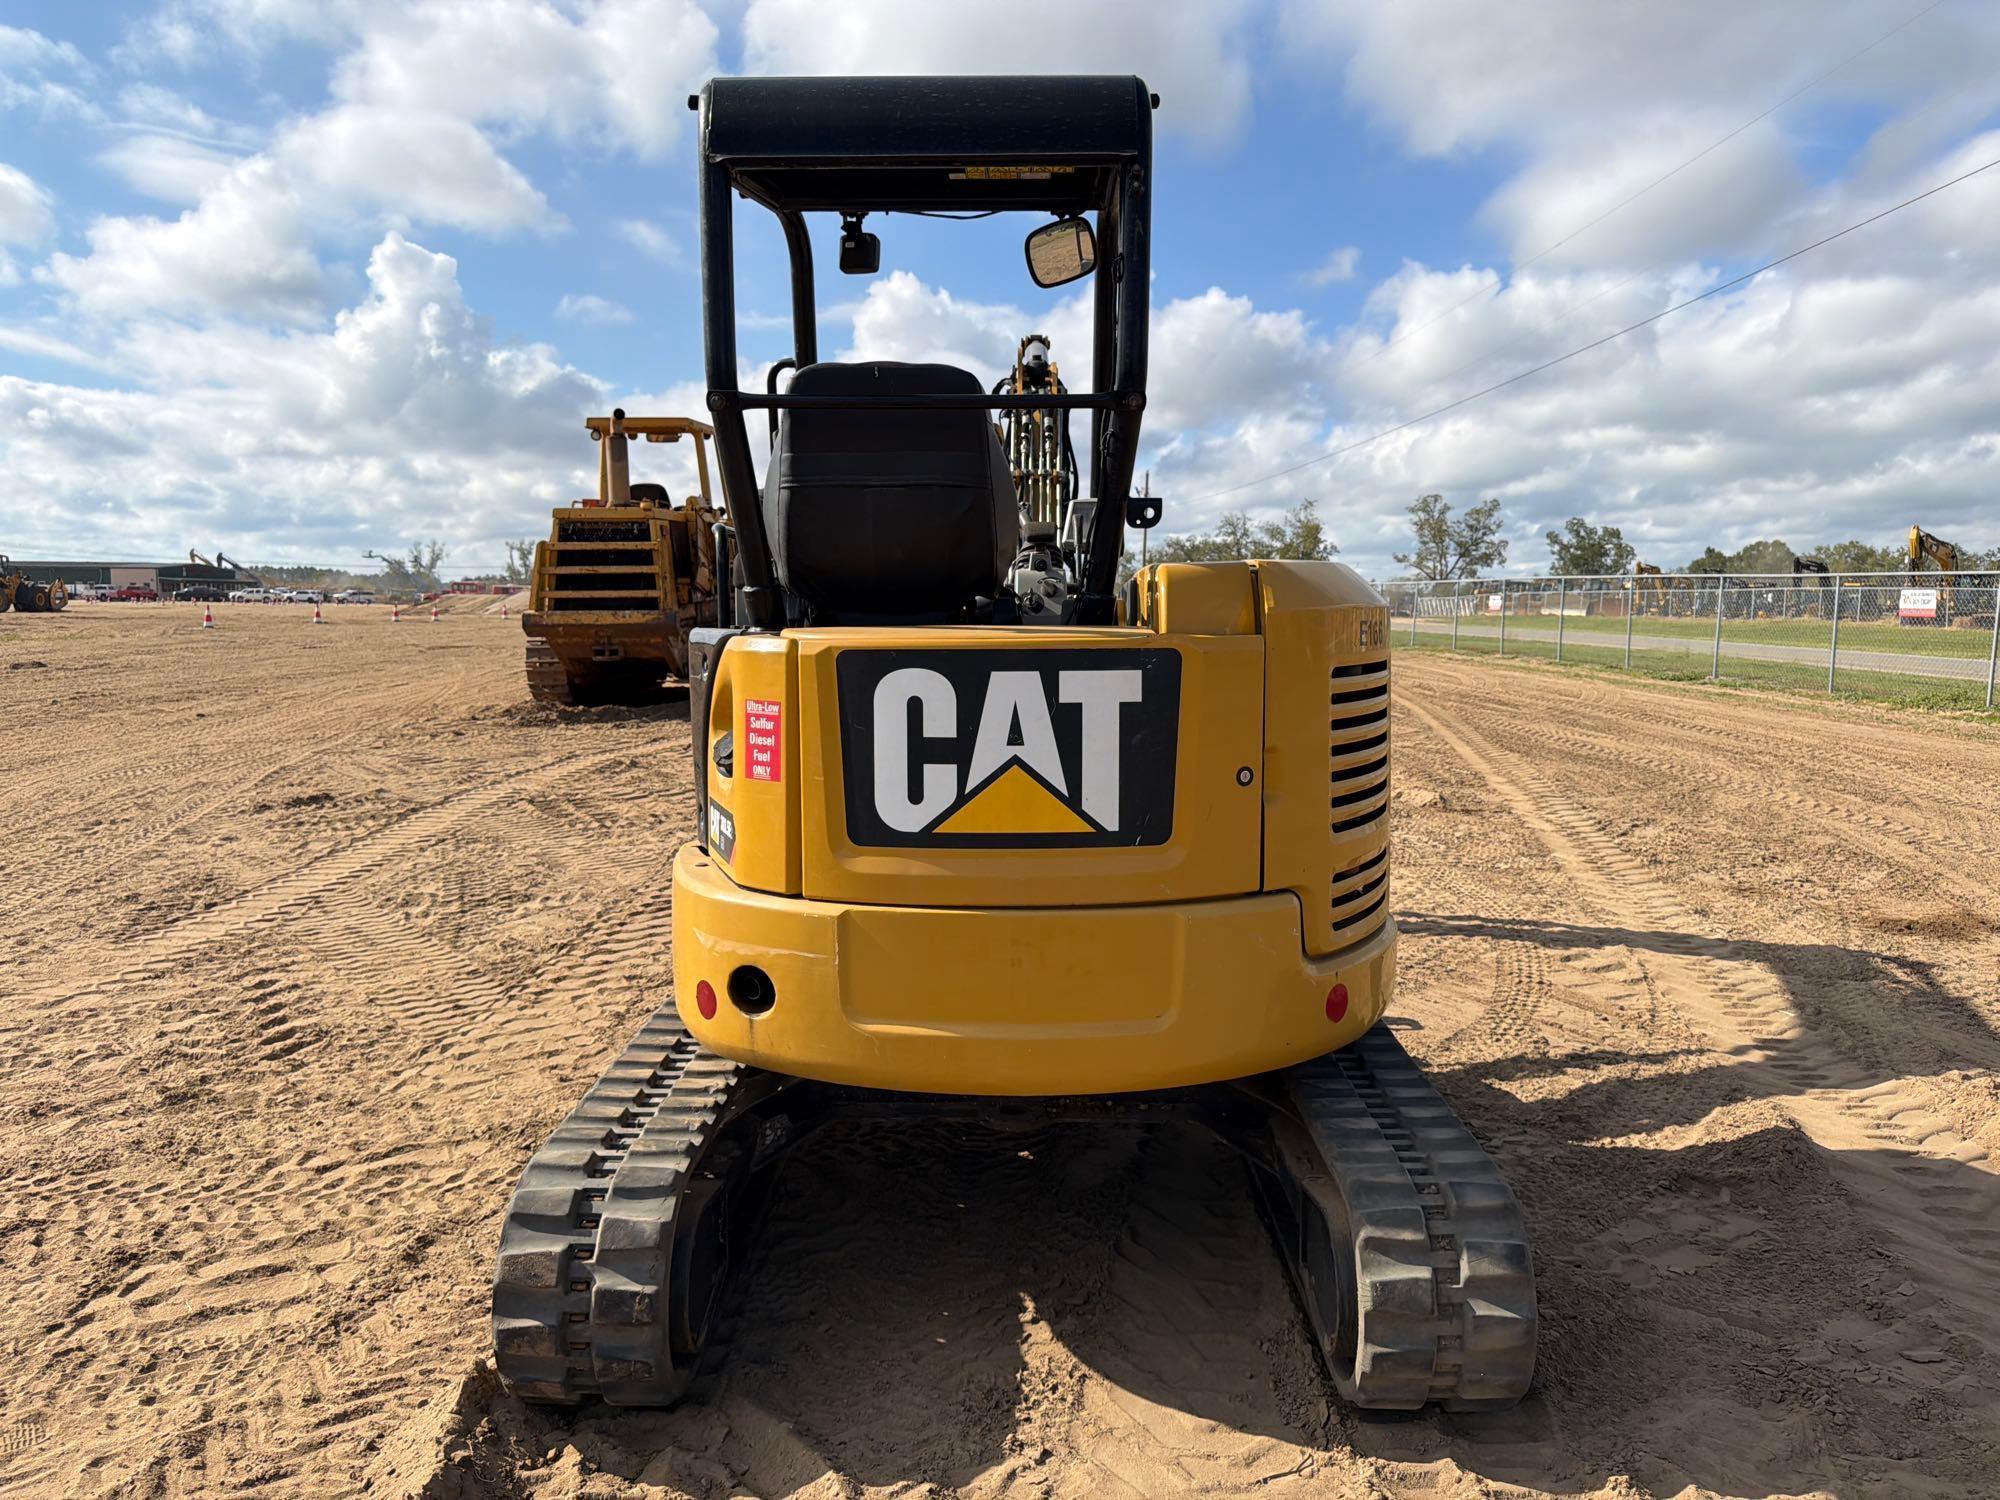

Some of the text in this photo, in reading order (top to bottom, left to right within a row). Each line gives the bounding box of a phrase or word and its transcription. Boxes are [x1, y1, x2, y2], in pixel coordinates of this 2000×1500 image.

[746, 700, 779, 713] Ultra-Low
[750, 716, 774, 730] Sulfur
[749, 732, 775, 746] Diesel
[753, 749, 770, 762] Fuel
[873, 667, 1142, 833] CAT
[752, 764, 771, 776] ONLY
